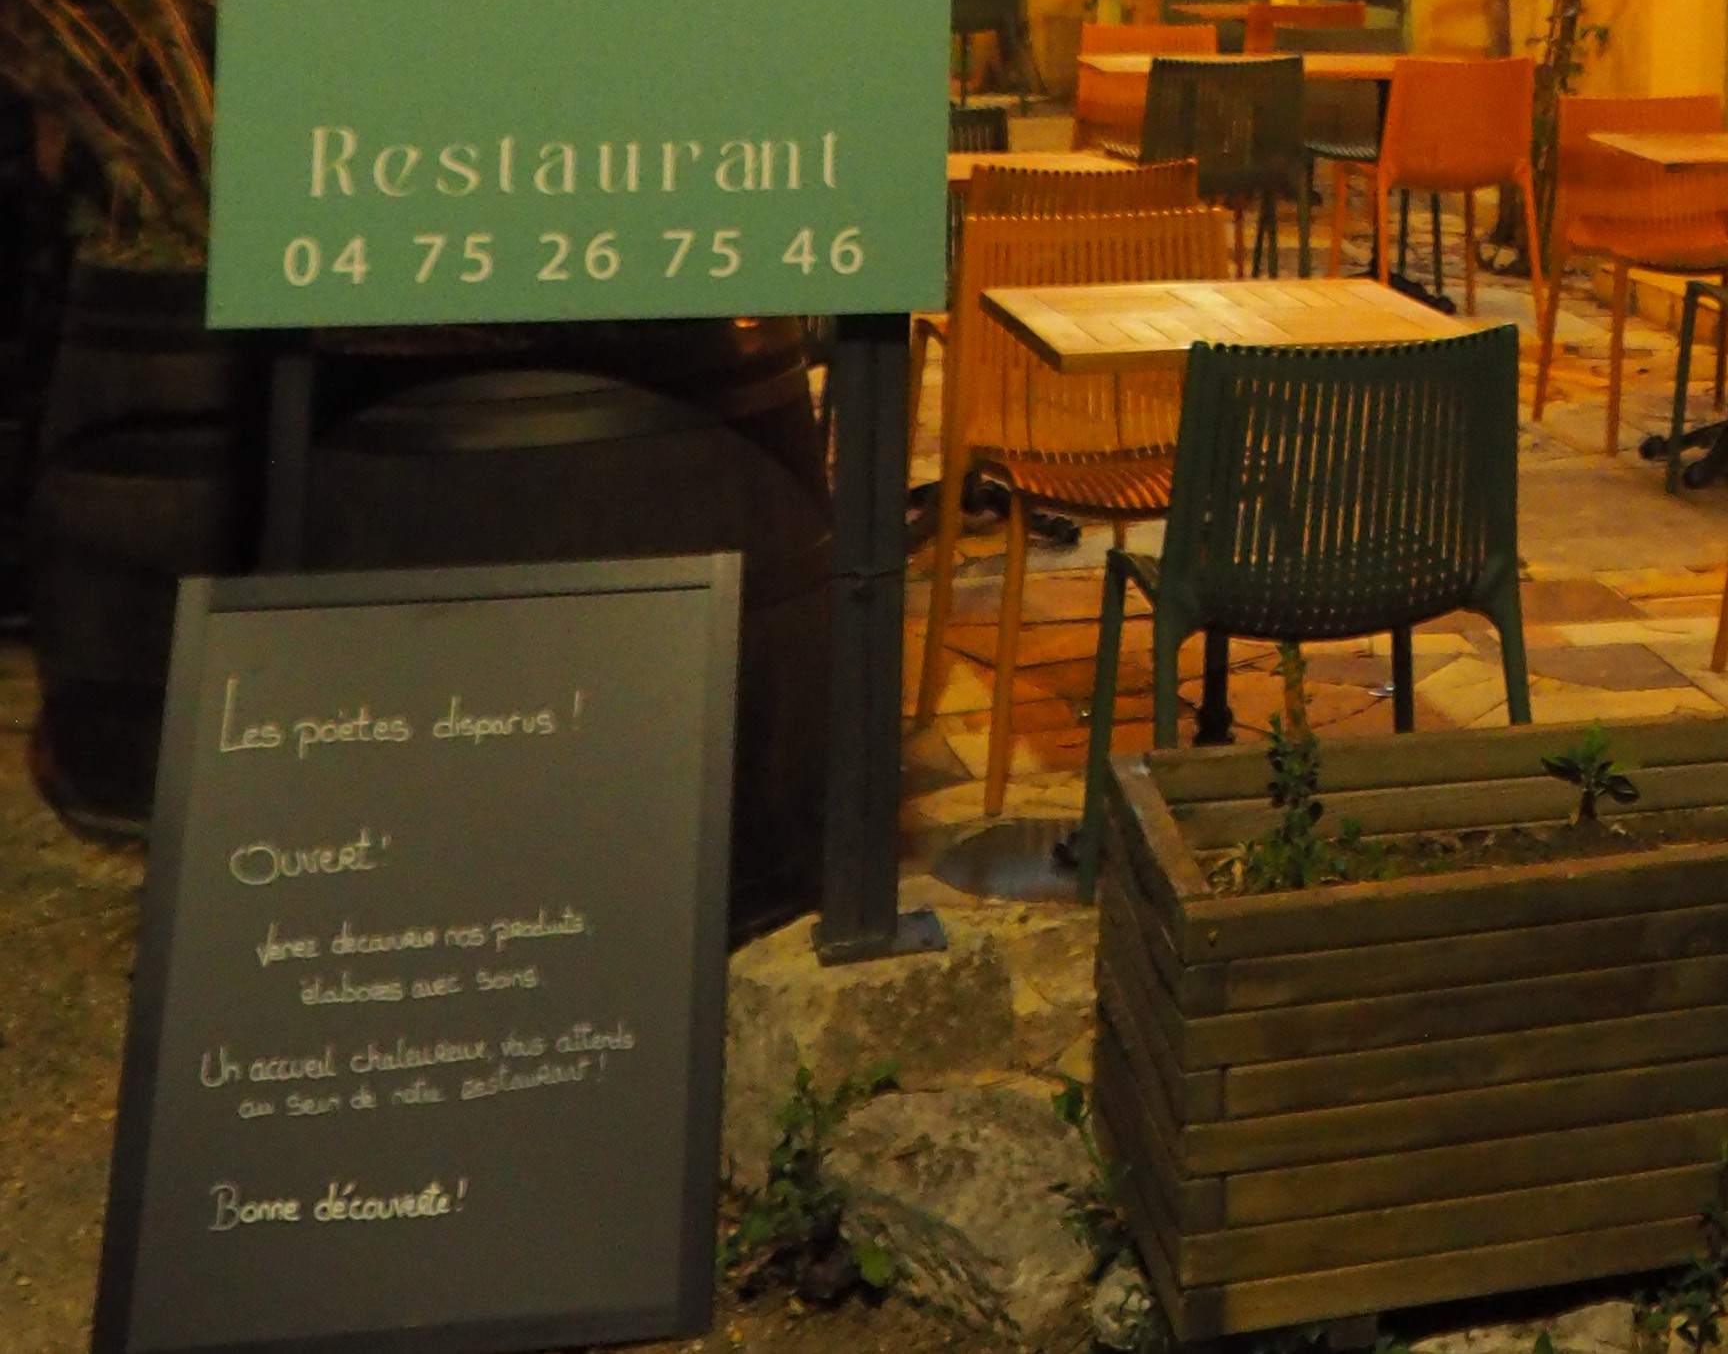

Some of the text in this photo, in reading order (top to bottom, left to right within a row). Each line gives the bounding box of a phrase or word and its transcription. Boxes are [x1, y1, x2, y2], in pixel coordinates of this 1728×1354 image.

[308, 125, 838, 197] Restaurant
[284, 226, 865, 286] 04 75 26 75 46
[219, 676, 281, 752] Les
[200, 1043, 239, 1088] Un
[249, 1044, 337, 1083] accueil
[237, 1099, 275, 1120] au
[207, 1181, 301, 1231] Bonne
